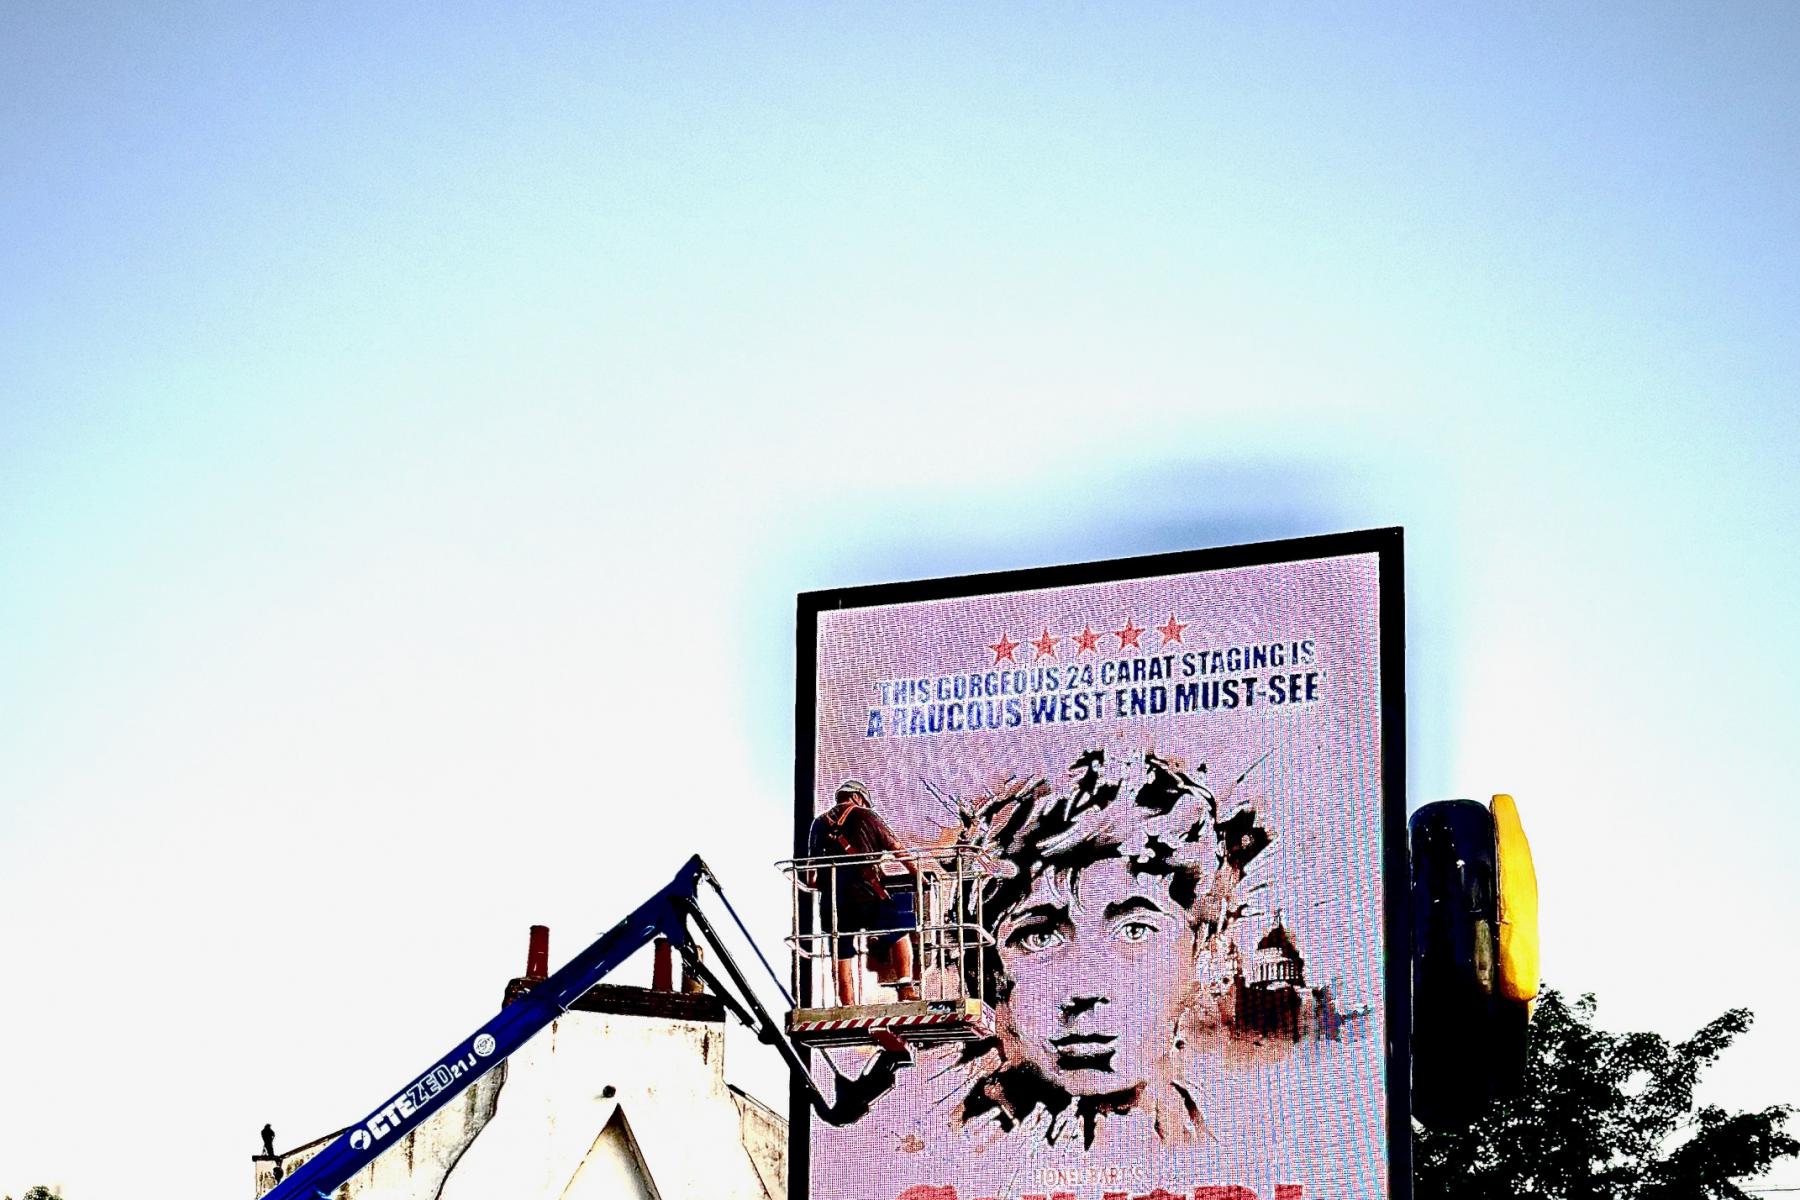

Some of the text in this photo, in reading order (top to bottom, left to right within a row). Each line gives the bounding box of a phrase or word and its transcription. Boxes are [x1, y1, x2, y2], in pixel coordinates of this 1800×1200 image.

[936, 666, 1060, 701] GORGEOUS
[1066, 663, 1093, 690] 24
[1101, 655, 1175, 685] CARAT
[1182, 643, 1284, 677] STAGING
[1291, 640, 1316, 665] IS
[865, 709, 885, 737] A
[893, 699, 1022, 736] RAUCOUS
[1030, 690, 1106, 724] WEST
[1116, 686, 1167, 717] END
